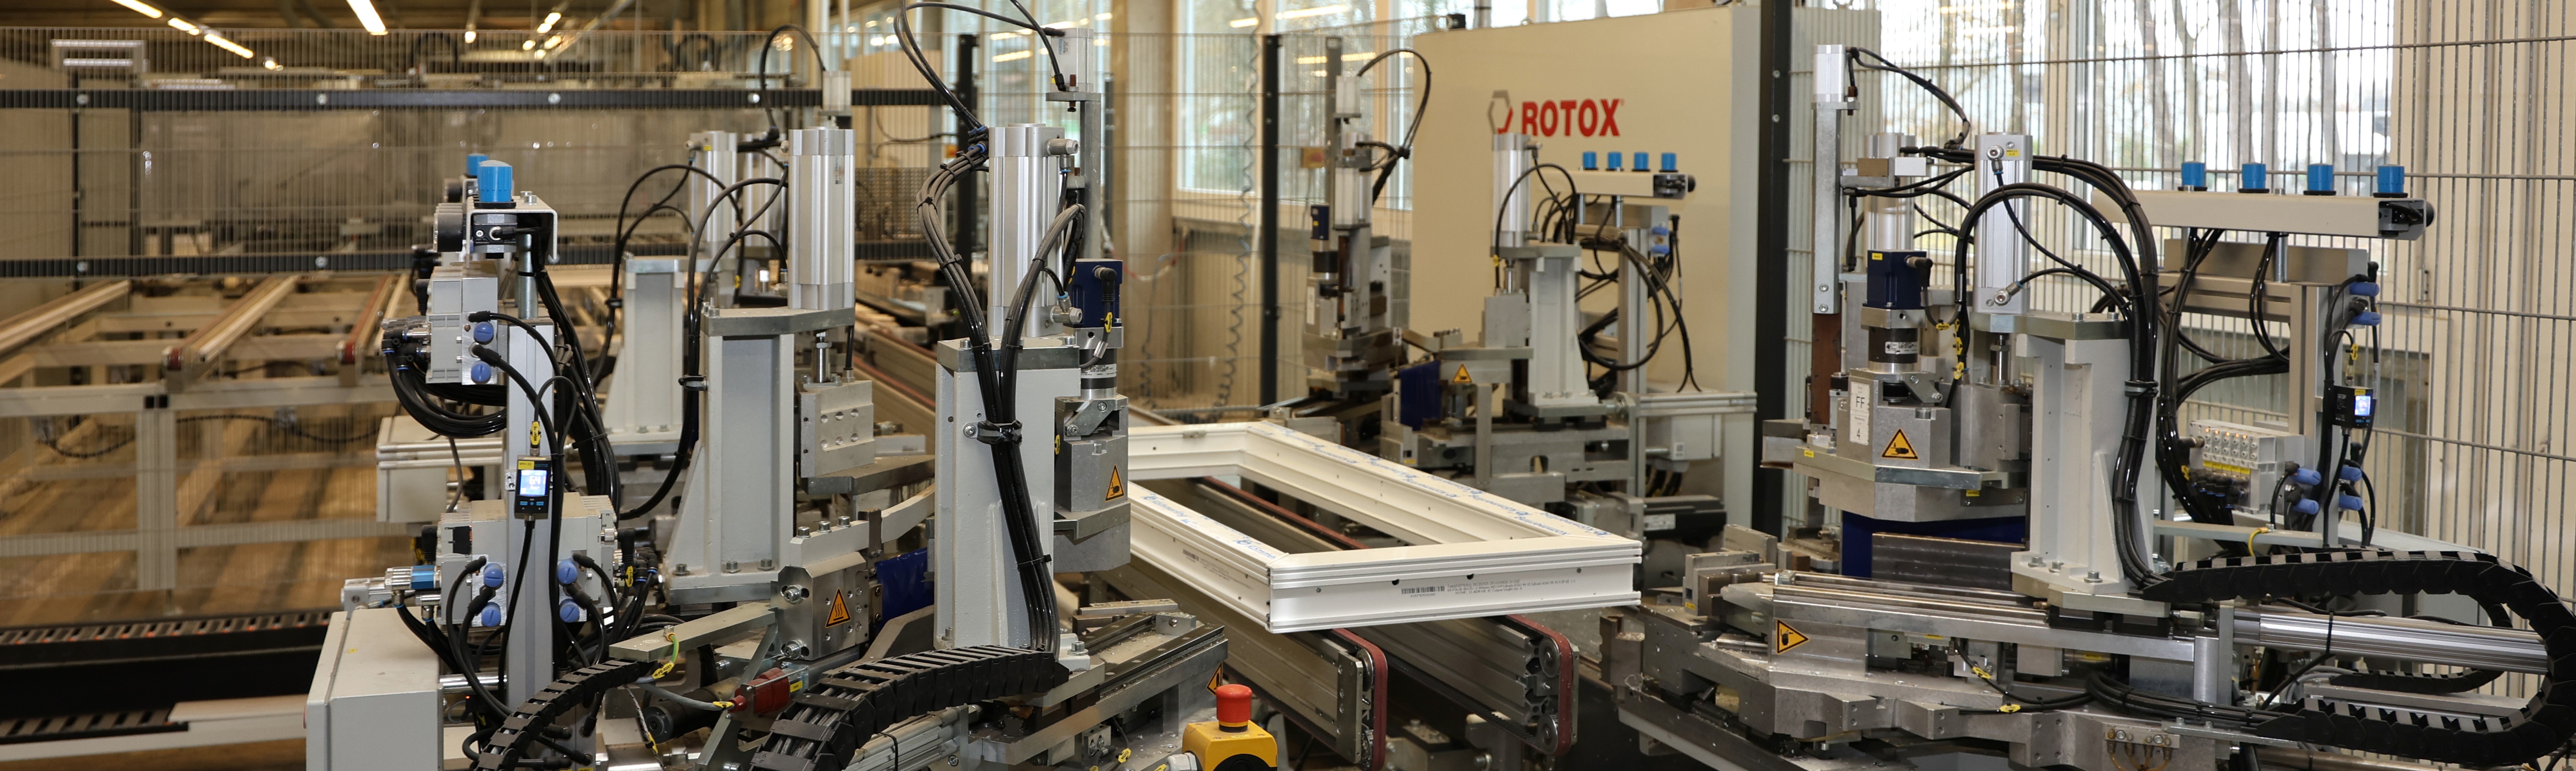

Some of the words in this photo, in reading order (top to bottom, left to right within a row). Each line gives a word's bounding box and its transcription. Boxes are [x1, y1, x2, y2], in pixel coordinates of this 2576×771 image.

[1522, 98, 1620, 137] ROTOX
[1856, 396, 1865, 408] FF
[1856, 428, 1861, 440] 4
